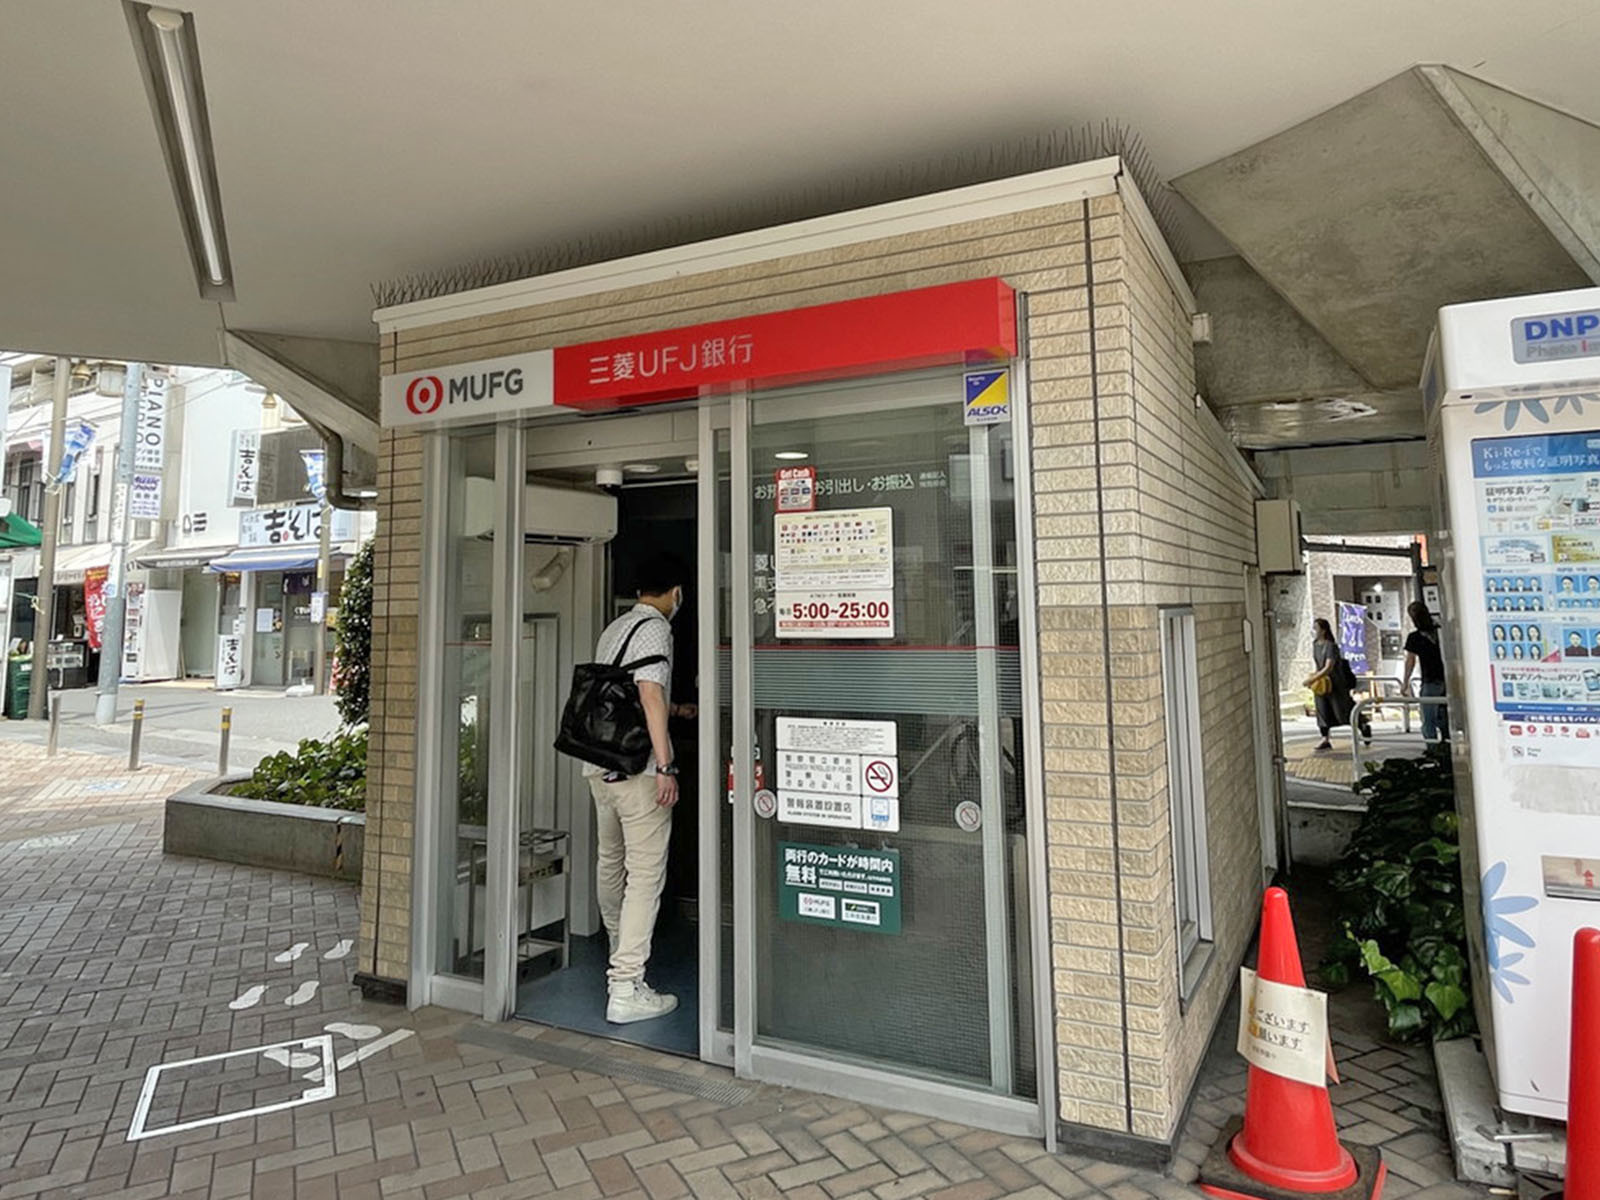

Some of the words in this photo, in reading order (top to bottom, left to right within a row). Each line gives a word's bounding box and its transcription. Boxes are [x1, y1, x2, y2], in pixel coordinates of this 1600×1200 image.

[1524, 315, 1600, 341] DNP
[588, 334, 754, 386] 三菱UFJ銀行
[448, 368, 524, 403] MUFG
[145, 378, 164, 446] PIANO
[967, 405, 1008, 417] ALSOK
[785, 848, 894, 874] 両行のカードが時間内
[786, 863, 817, 884] 無料
